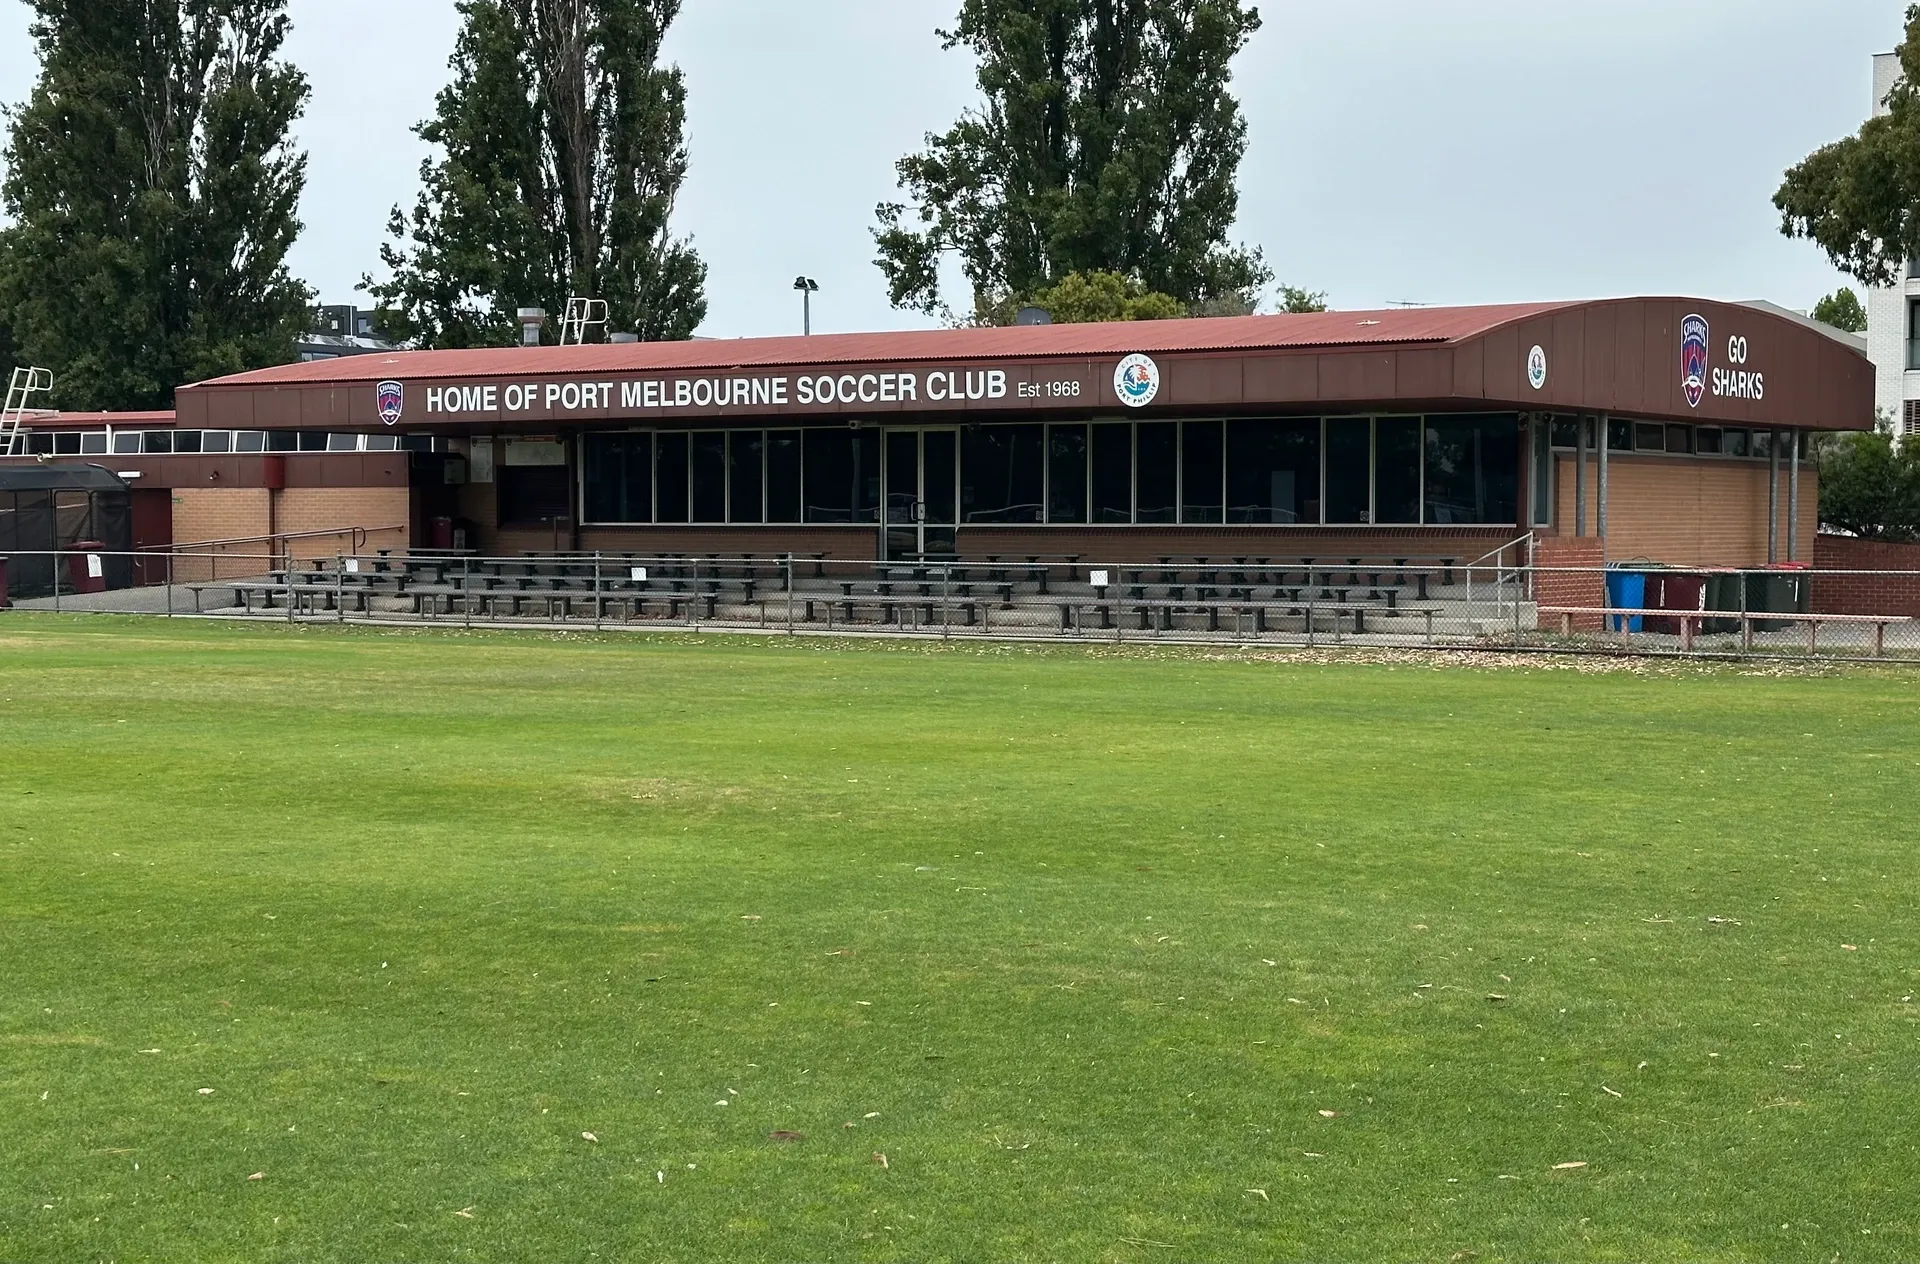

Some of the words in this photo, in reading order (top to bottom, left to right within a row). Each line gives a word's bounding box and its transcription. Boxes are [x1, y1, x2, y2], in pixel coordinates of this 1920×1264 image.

[1684, 321, 1706, 347] SHARKS
[1728, 336, 1747, 363] GO
[426, 385, 497, 412] HOME
[504, 384, 538, 411] OF
[545, 382, 613, 410] PORT
[621, 377, 788, 408] MELBOURNE
[796, 373, 917, 404] SOCCER
[926, 370, 1007, 400] CLUB
[1018, 382, 1041, 398] Est
[1045, 381, 1080, 398] 1968
[1117, 384, 1130, 401] PORT
[1133, 383, 1156, 403] PHILLIP
[1712, 367, 1764, 400] SHARKS
